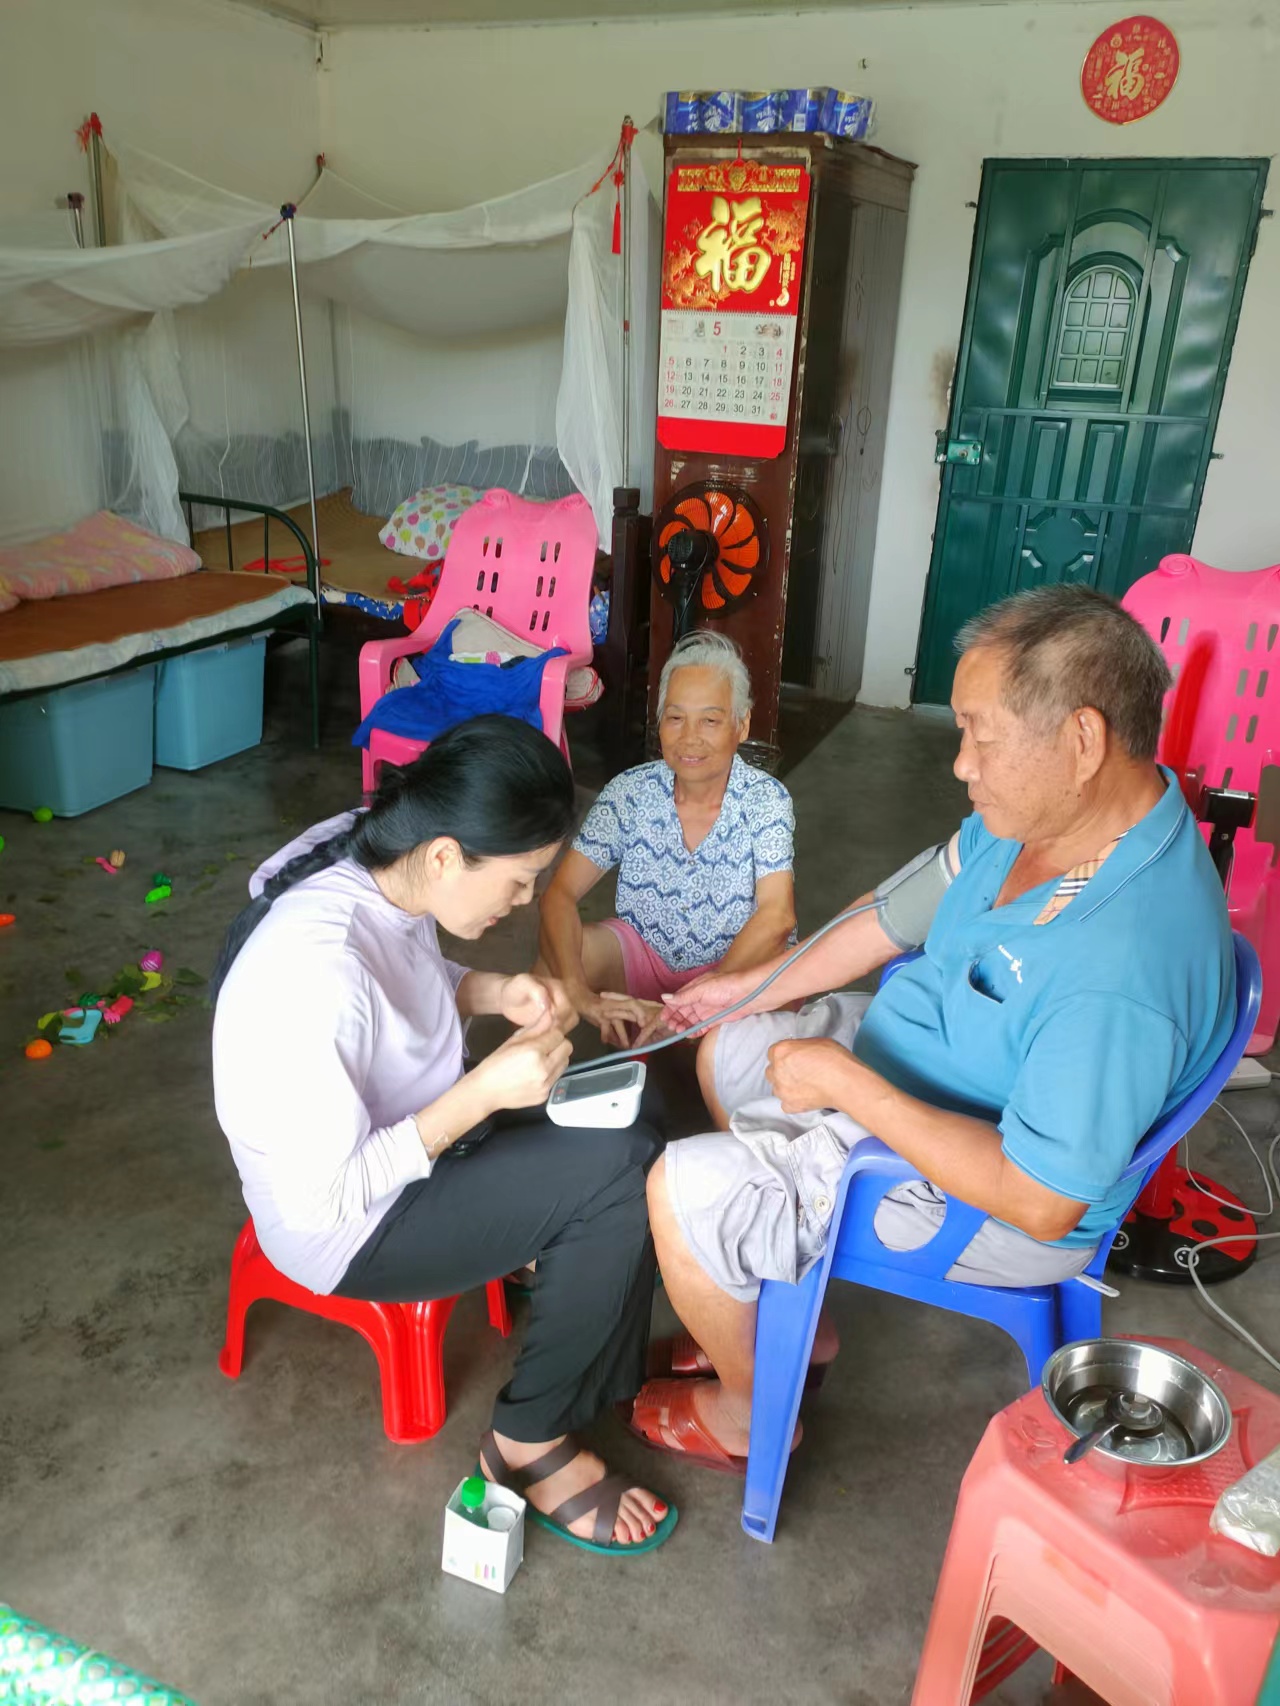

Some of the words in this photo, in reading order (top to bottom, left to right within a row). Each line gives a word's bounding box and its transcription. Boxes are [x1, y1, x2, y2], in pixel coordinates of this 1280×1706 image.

[1104, 48, 1145, 100] 福
[695, 196, 771, 293] 福
[713, 321, 721, 336] 5
[740, 346, 746, 355] 2
[759, 347, 764, 356] 3
[777, 349, 782, 357] 4
[686, 358, 691, 366] 6
[704, 359, 709, 367] 7
[721, 360, 727, 368] 8
[740, 361, 745, 369] 9
[756, 362, 765, 370] 10
[775, 364, 782, 372] 11
[667, 372, 675, 380] 12
[719, 375, 727, 383] 15
[737, 376, 746, 384] 16
[773, 378, 782, 386] 18
[682, 387, 691, 395] 20
[717, 389, 726, 397] 22
[735, 390, 744, 398] 23
[753, 391, 762, 399] 24
[681, 400, 690, 408] 27
[716, 403, 725, 411] 29
[734, 404, 743, 412] 30
[752, 406, 761, 414] 31
